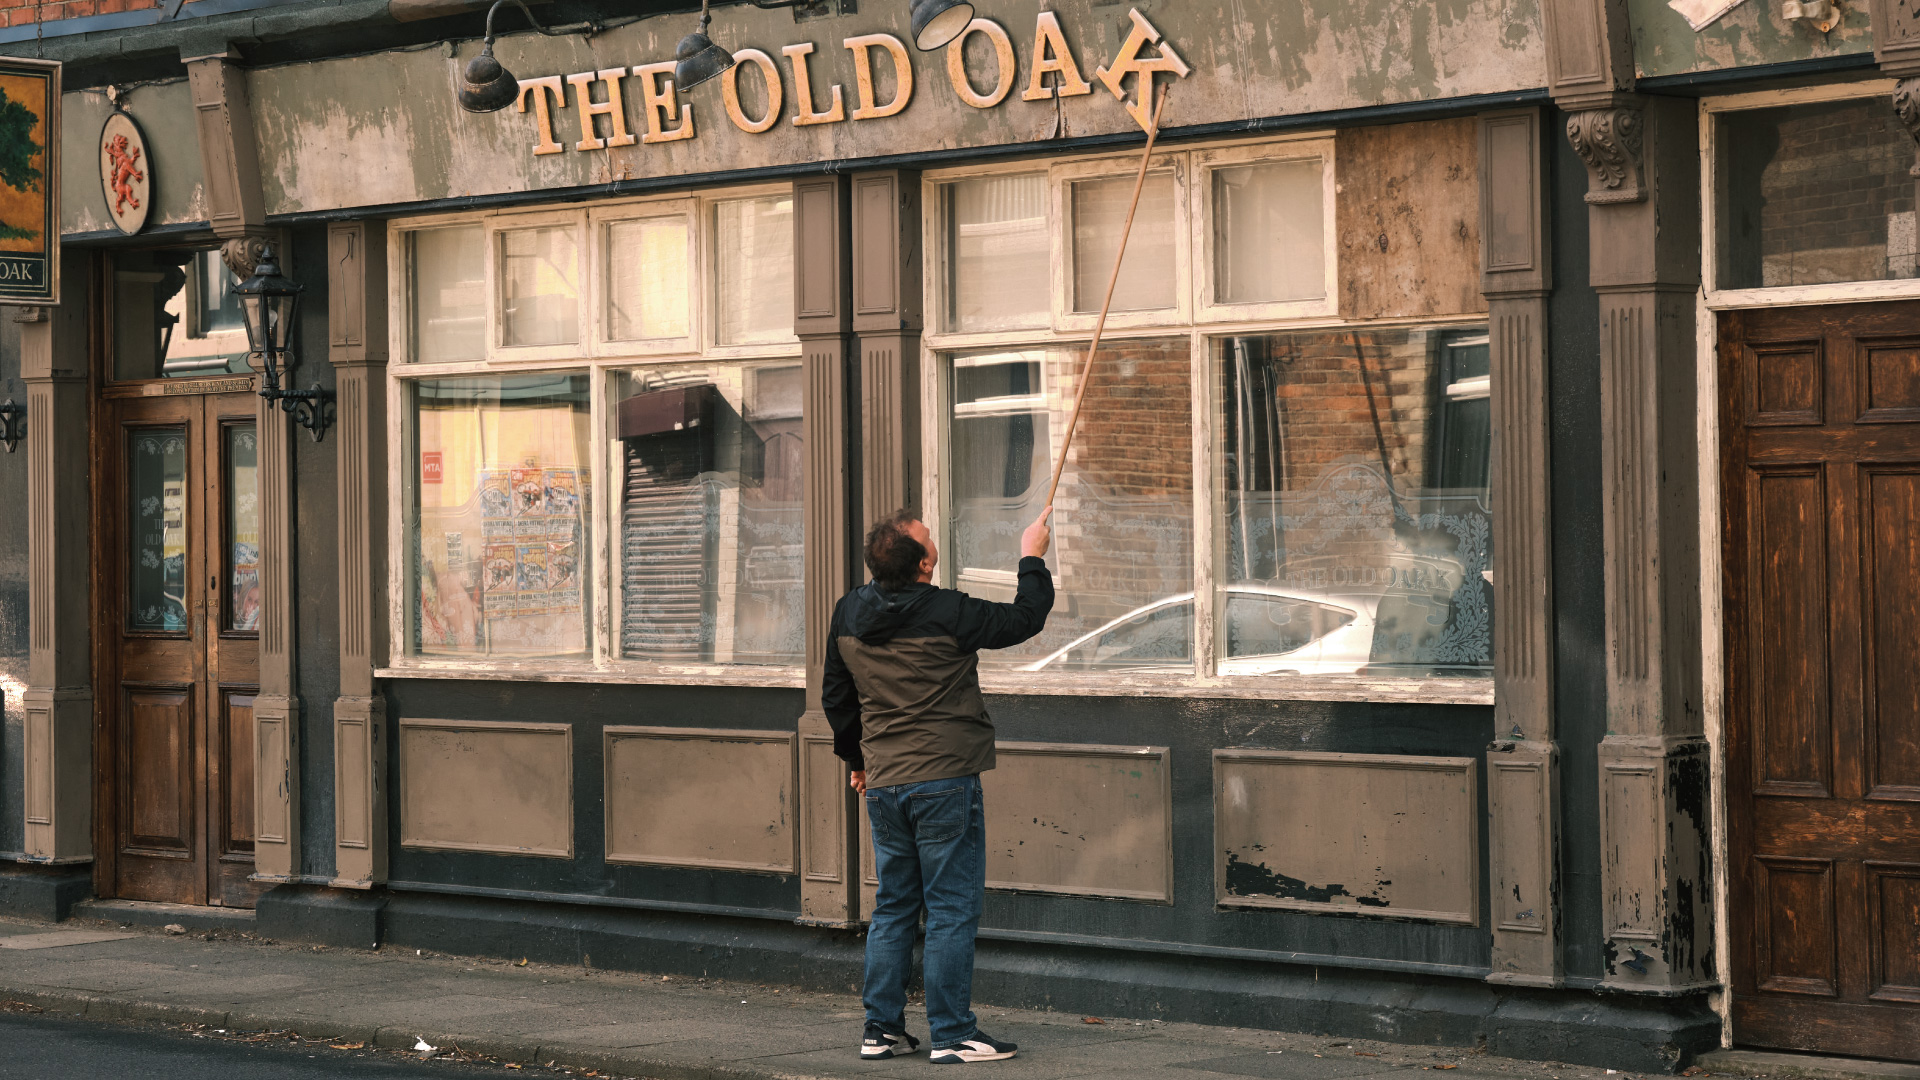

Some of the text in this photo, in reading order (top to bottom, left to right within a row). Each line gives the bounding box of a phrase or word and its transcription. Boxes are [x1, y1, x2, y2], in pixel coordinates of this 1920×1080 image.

[517, 5, 1190, 156] THE OLD OAK
[0, 261, 33, 281] OAK
[1286, 567, 1328, 591] THE
[1332, 565, 1377, 587] OLD
